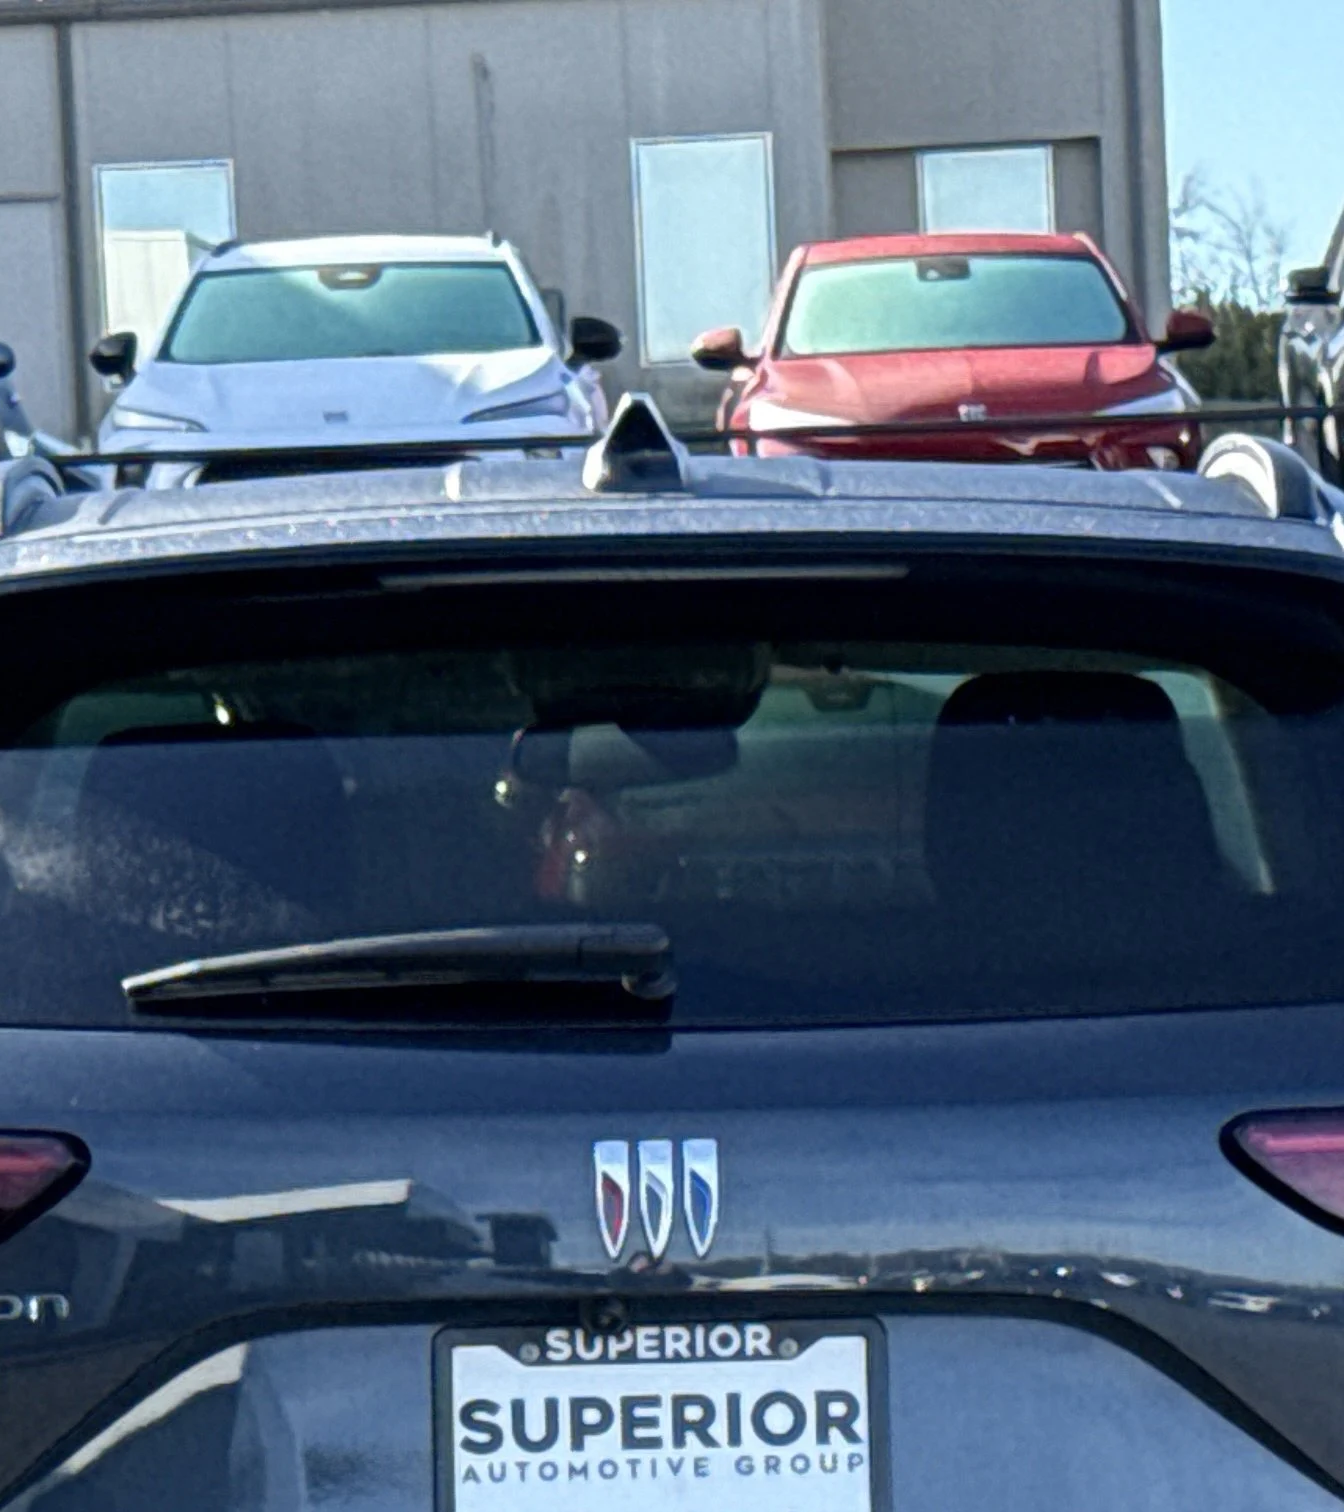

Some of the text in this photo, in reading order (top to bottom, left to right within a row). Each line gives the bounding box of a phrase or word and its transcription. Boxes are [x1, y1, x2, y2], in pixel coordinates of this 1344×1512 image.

[544, 1322, 773, 1361] SUPERIOR
[459, 1389, 863, 1455] SUPERIOR
[461, 1452, 865, 1484] AUTOMOTIVE GROUP
